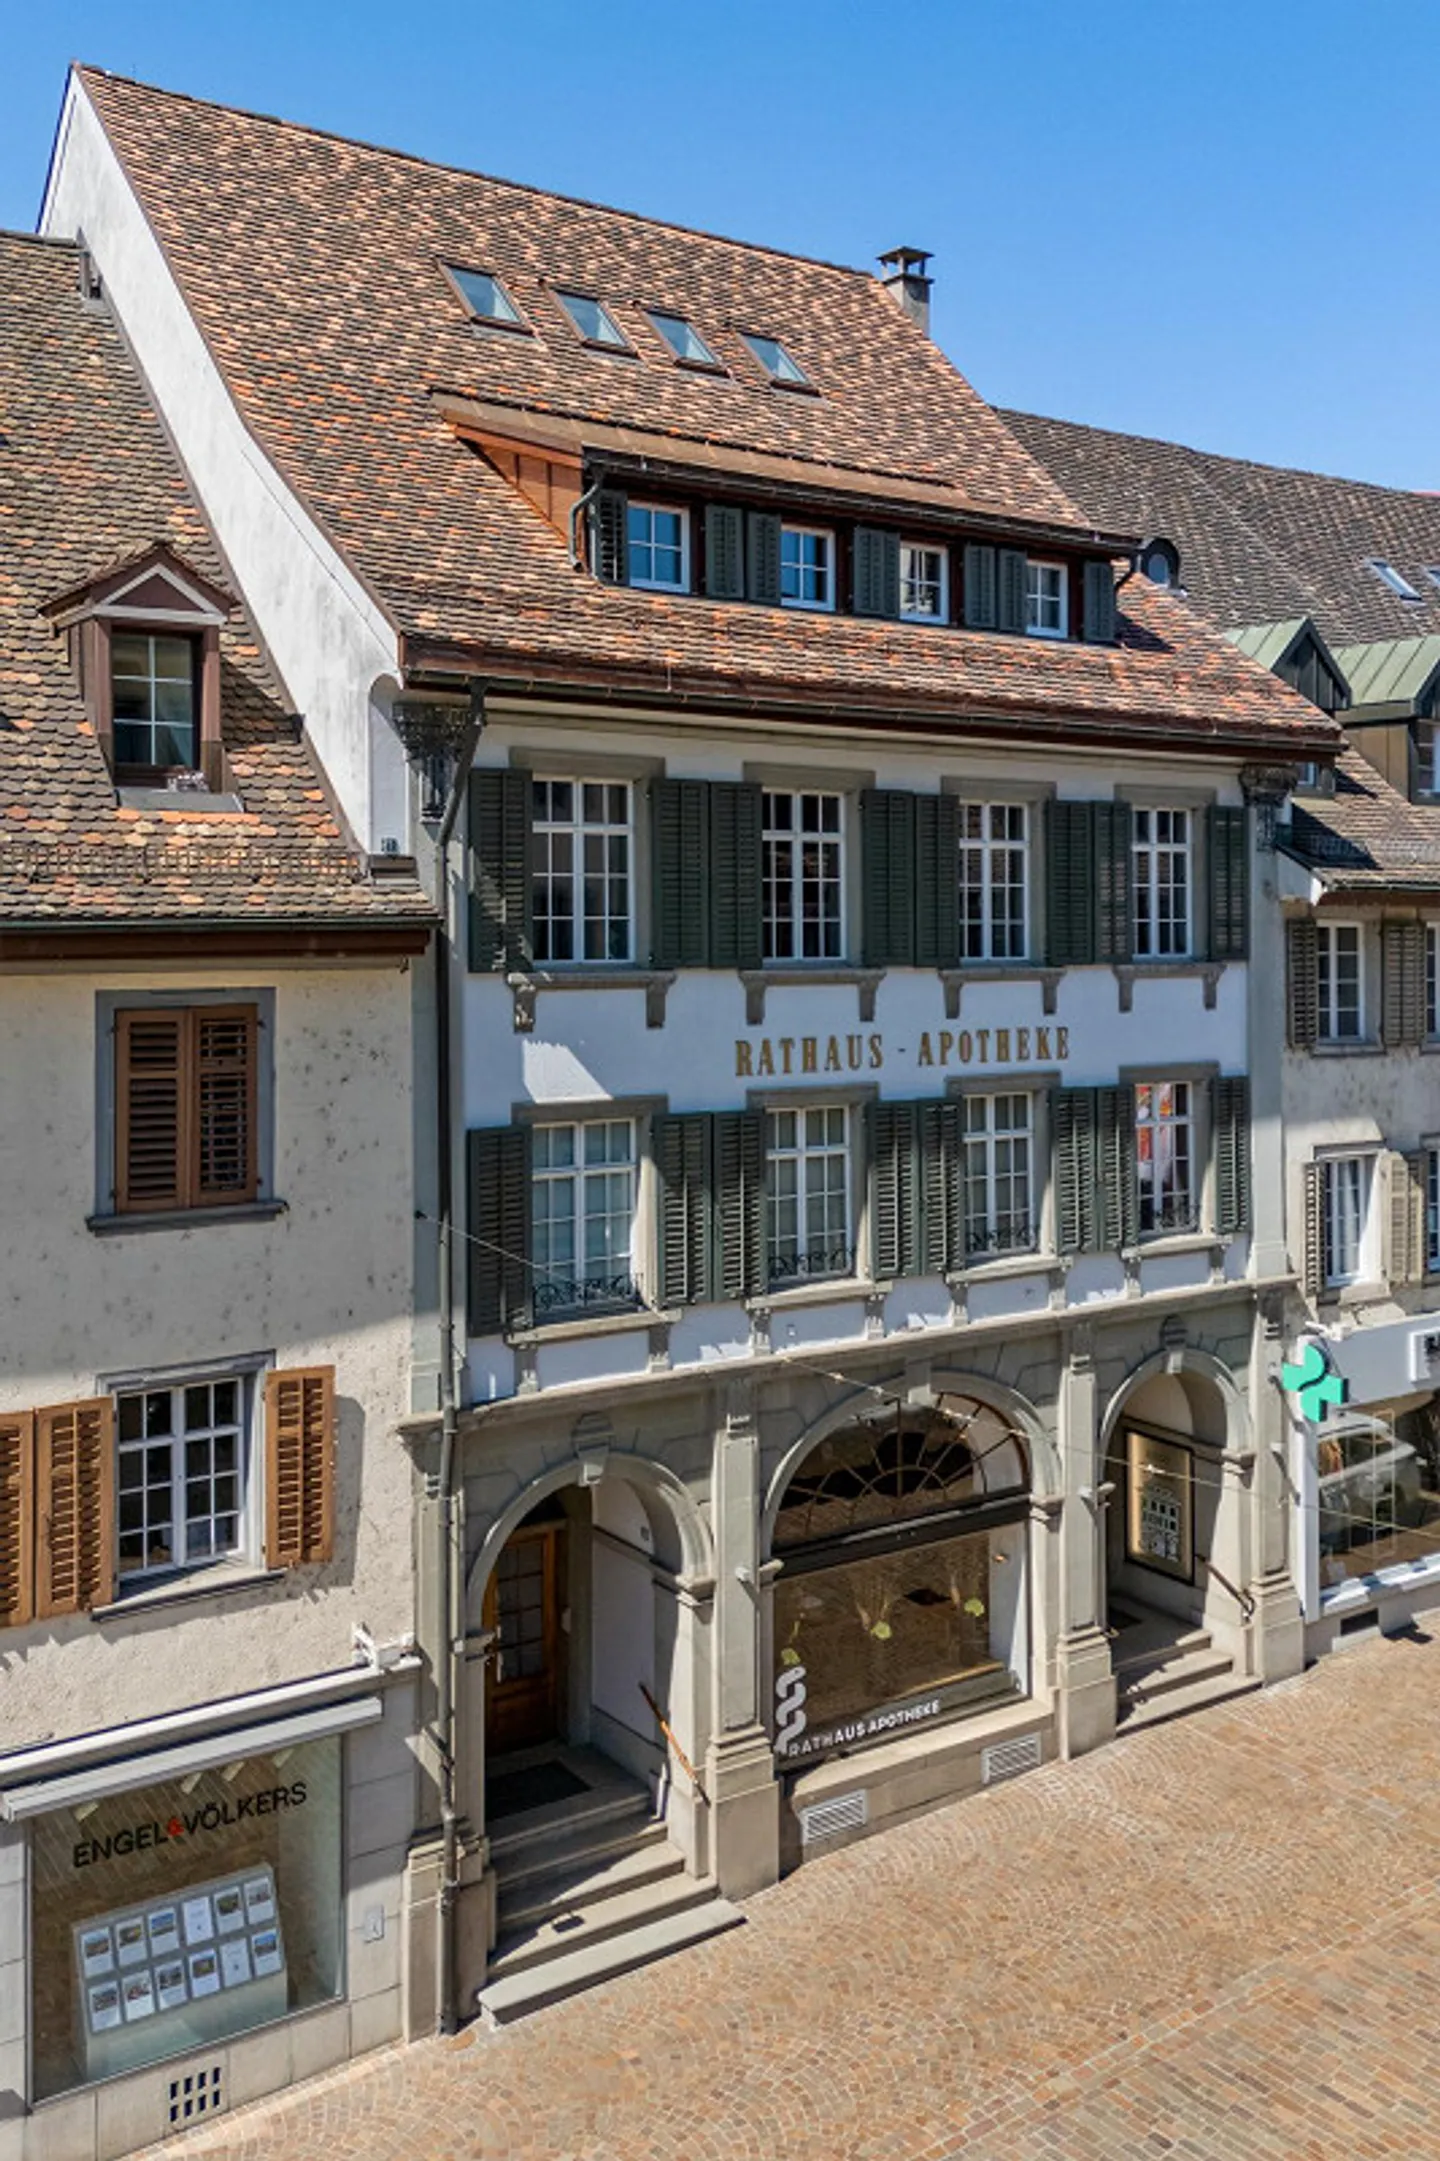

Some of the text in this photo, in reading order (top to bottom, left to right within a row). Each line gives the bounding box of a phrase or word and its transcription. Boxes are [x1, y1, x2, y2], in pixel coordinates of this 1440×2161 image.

[735, 1034, 883, 1076] RATHAUS
[918, 1027, 1070, 1067] APOTHEKE
[789, 1699, 941, 1757] RATHAUS APOTHEKE
